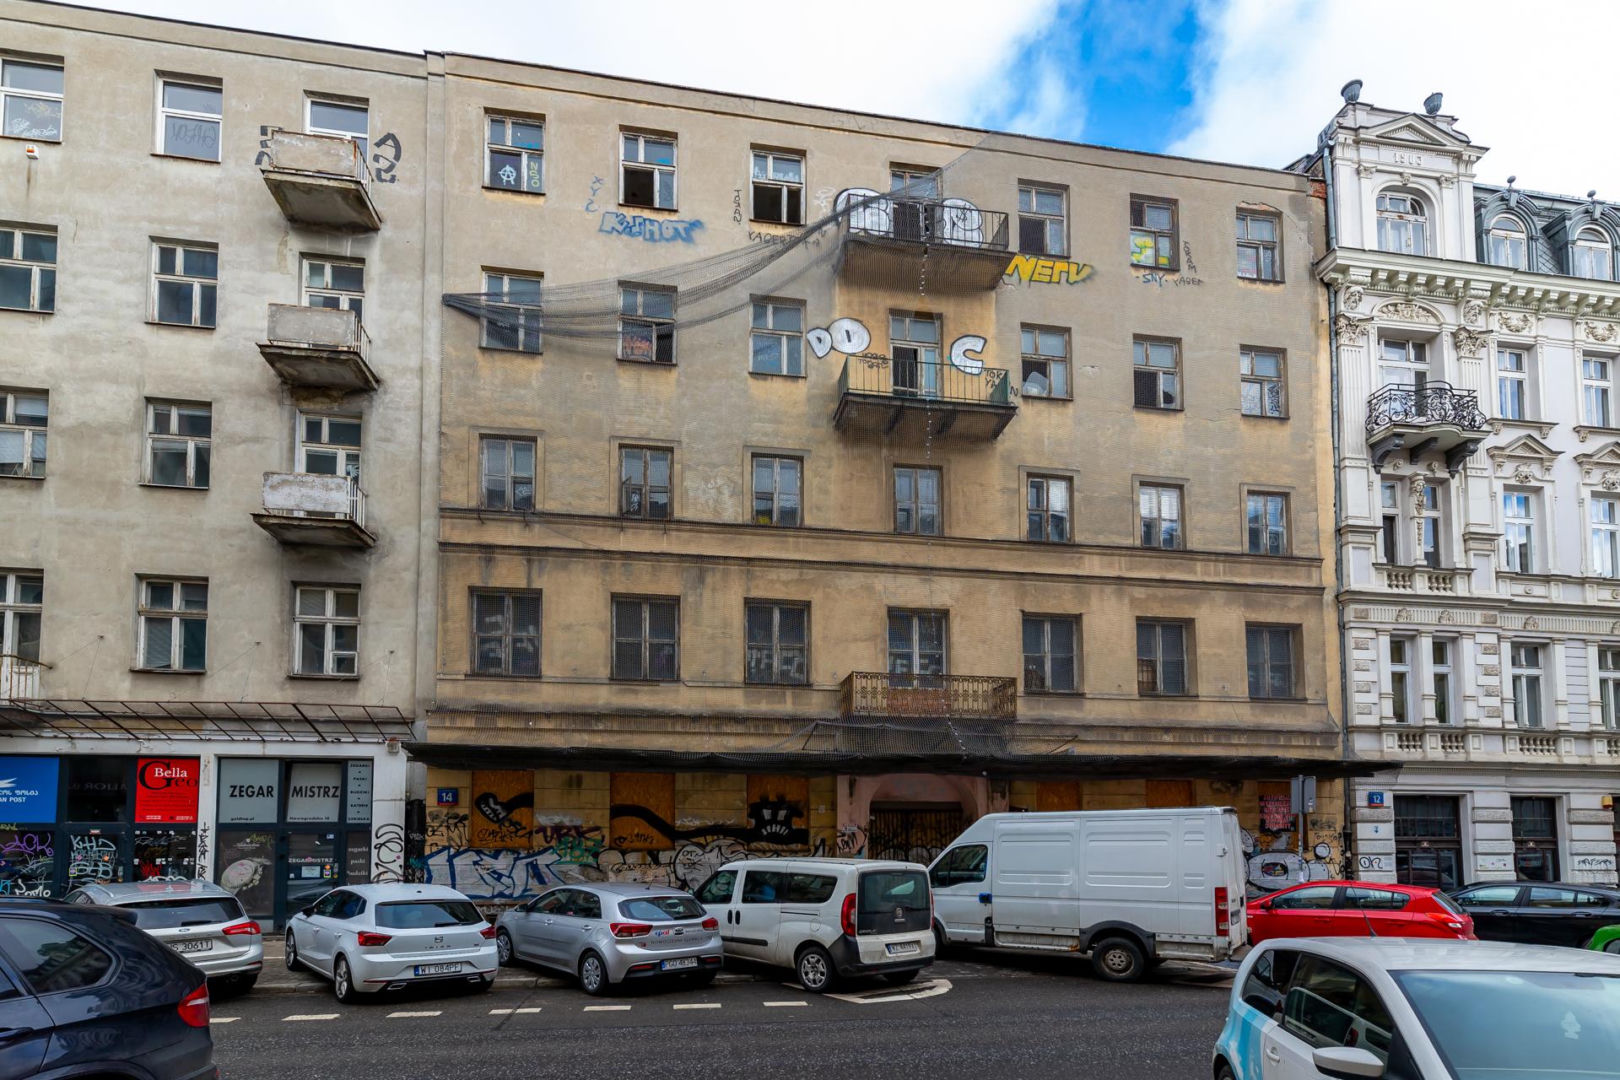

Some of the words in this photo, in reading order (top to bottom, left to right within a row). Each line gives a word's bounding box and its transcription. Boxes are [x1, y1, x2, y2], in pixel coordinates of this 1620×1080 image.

[154, 767, 188, 778] Bella
[229, 785, 274, 798] ZEGAR
[291, 786, 340, 798] MISTRZ
[441, 792, 453, 802] 14
[1373, 795, 1381, 804] 12
[183, 940, 210, 951] 3061T
